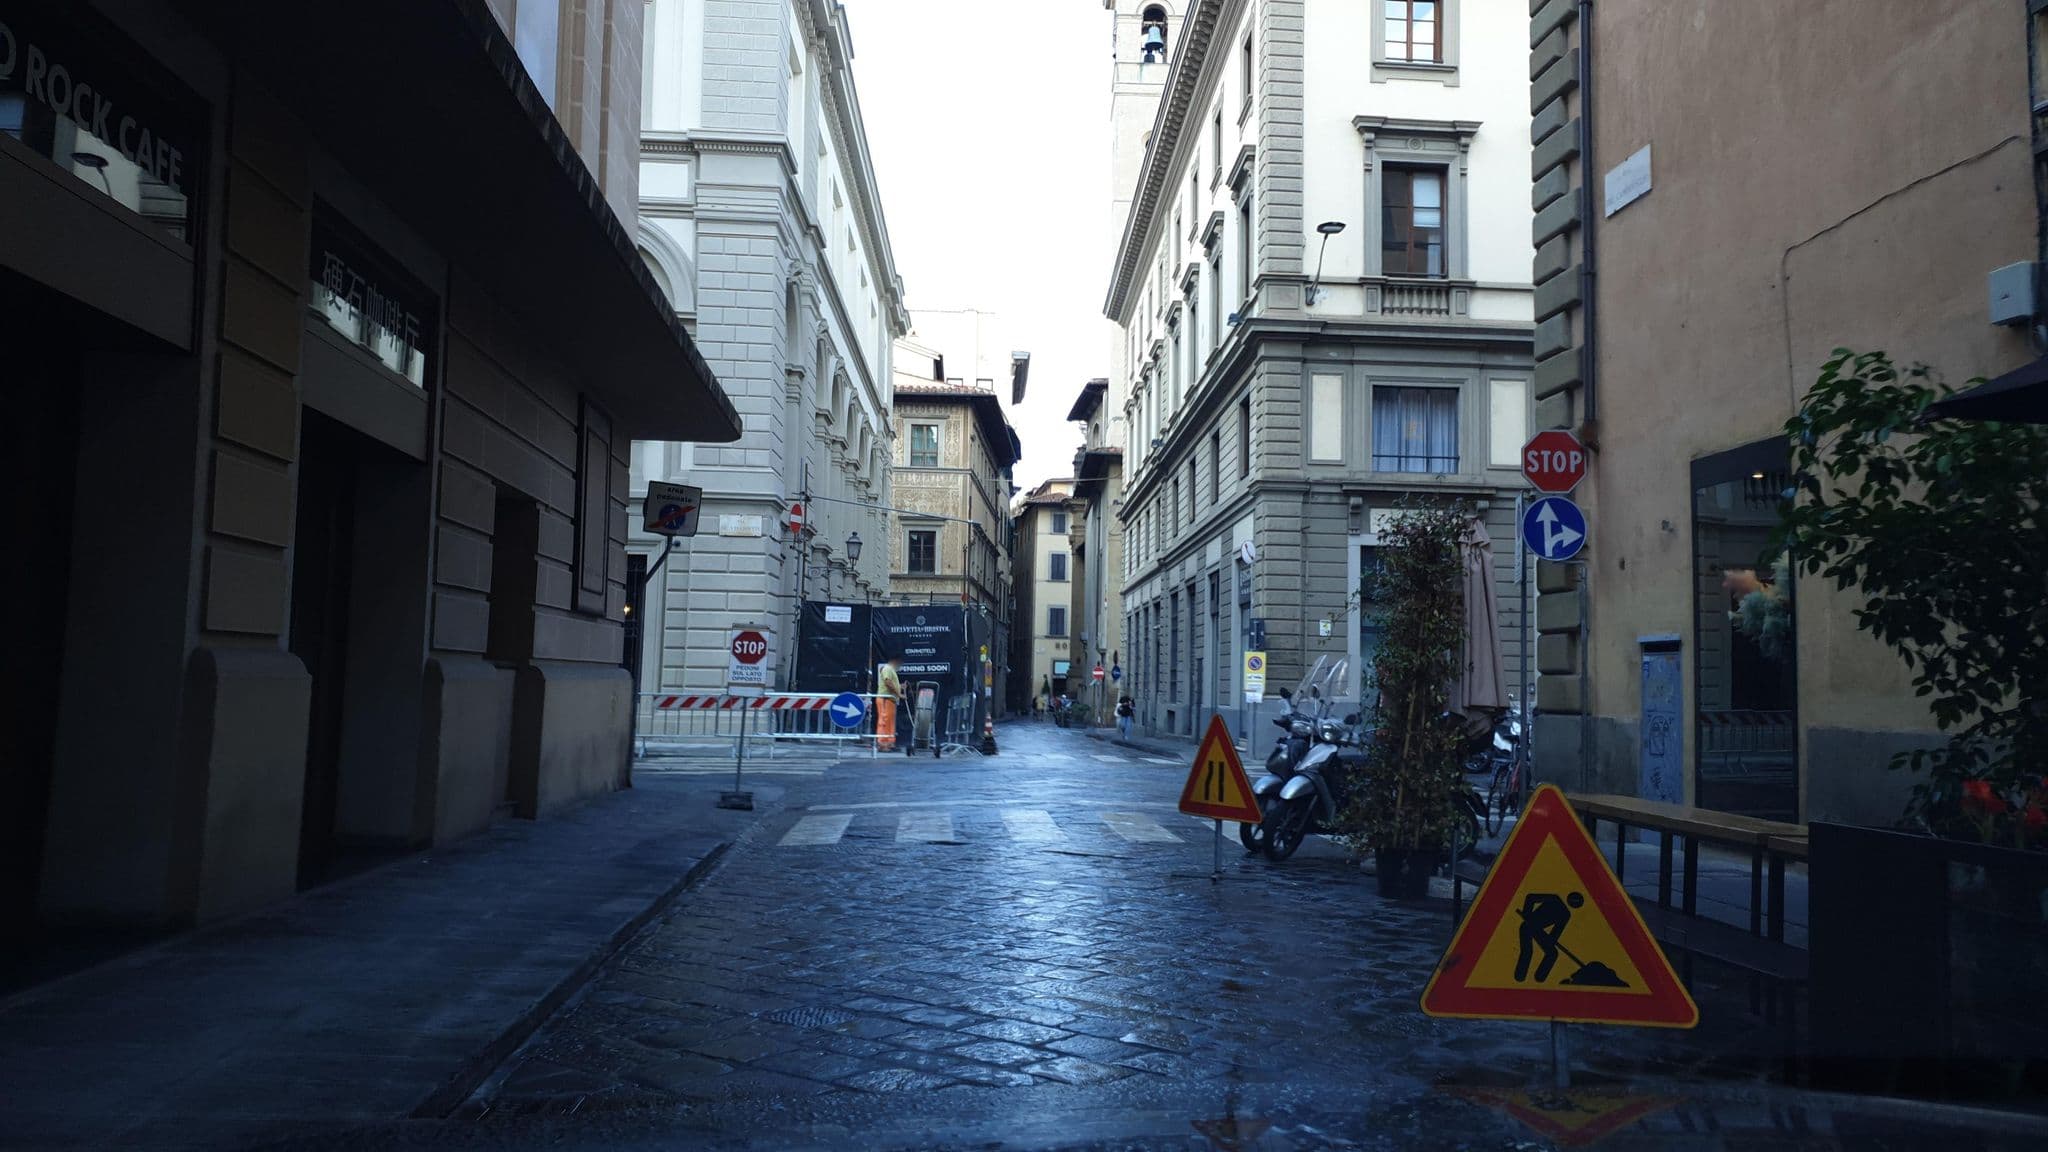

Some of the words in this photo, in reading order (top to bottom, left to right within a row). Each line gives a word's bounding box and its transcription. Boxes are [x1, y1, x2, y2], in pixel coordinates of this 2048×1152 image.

[25, 43, 113, 146] ROCK
[119, 114, 184, 187] CAFE
[1526, 449, 1582, 473] STOP
[734, 641, 765, 655] STOP
[926, 664, 948, 672] SOON
